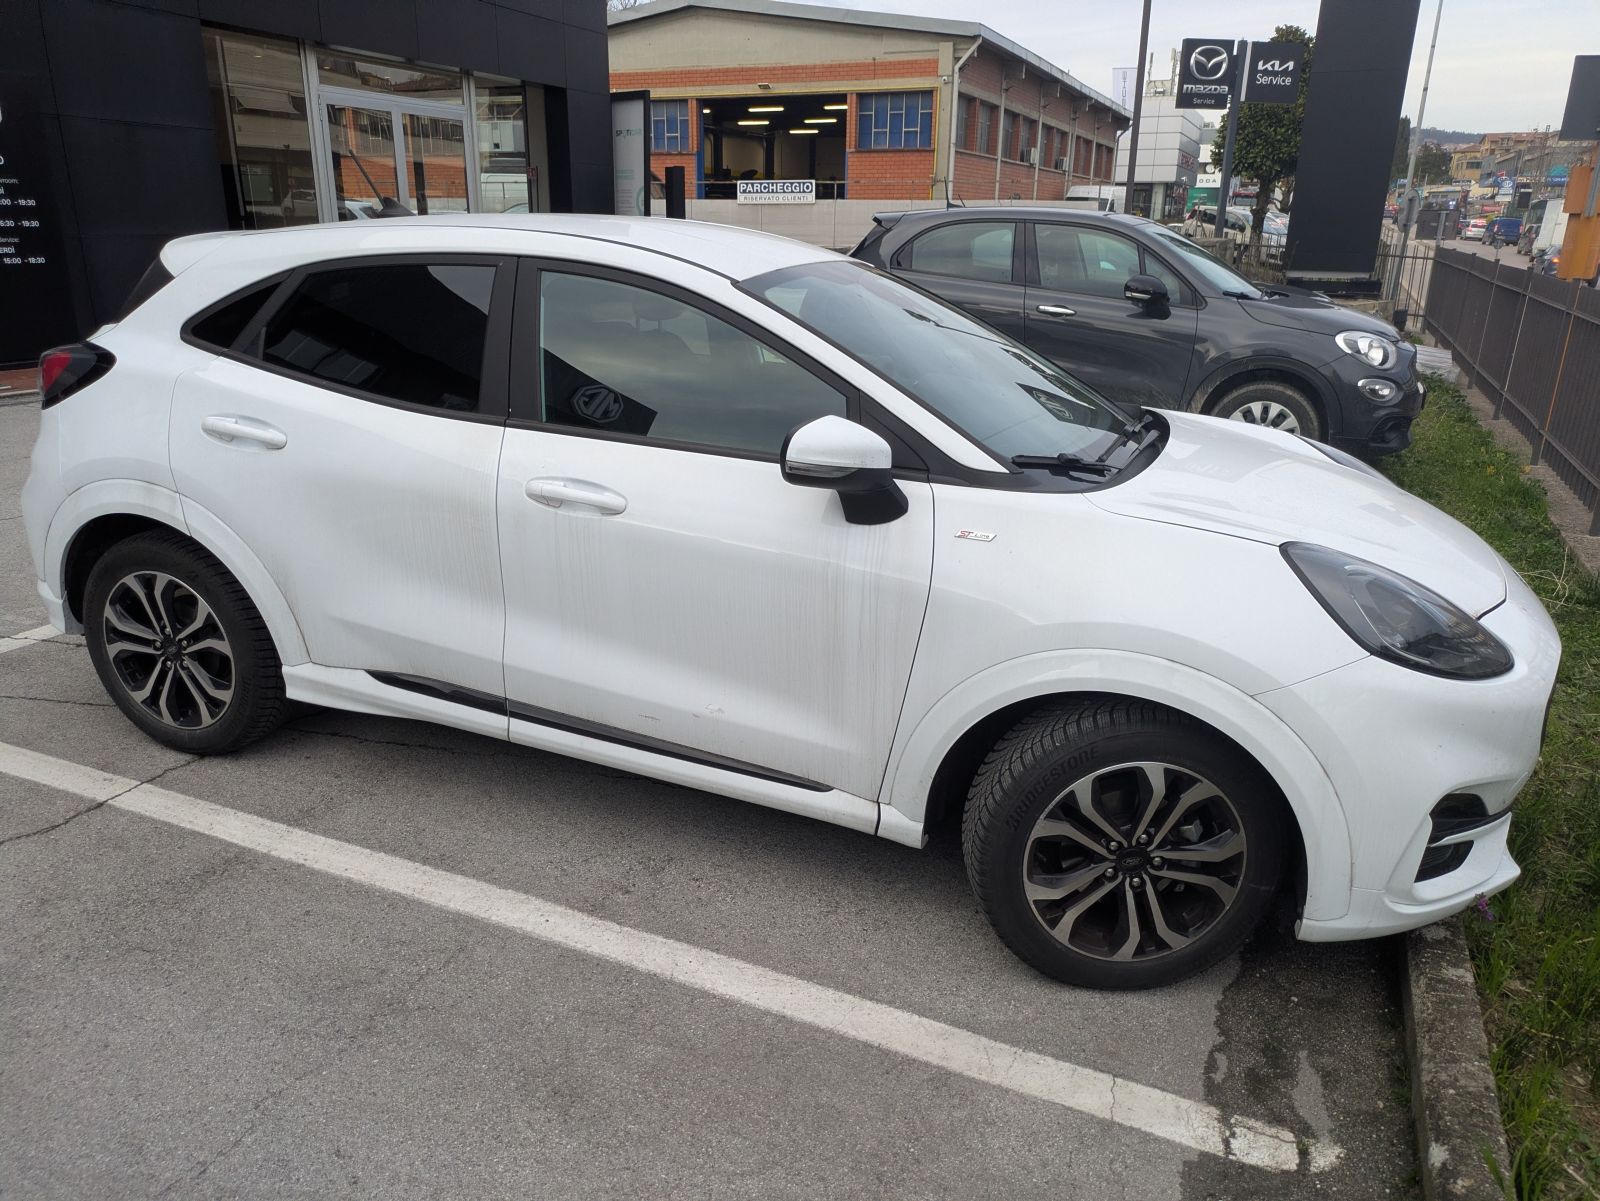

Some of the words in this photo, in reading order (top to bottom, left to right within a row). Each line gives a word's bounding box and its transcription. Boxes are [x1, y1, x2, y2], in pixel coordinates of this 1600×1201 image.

[1257, 60, 1295, 71] KIA
[1255, 73, 1292, 86] Service
[1193, 97, 1215, 105] Service
[740, 182, 812, 193] PARCHEGGIO
[960, 530, 974, 539] ST
[1005, 746, 1100, 831] BRIDGESTONE
